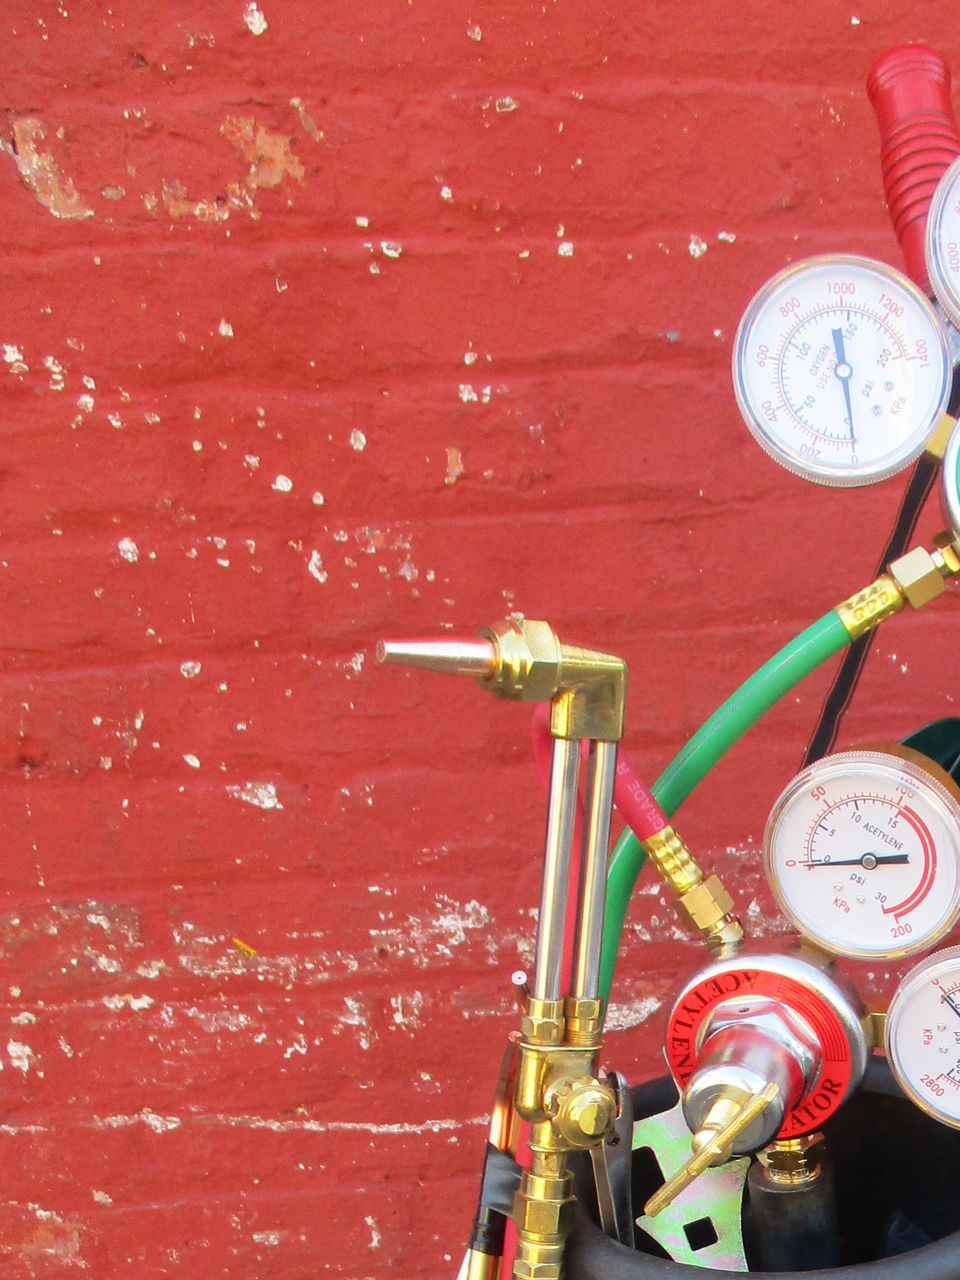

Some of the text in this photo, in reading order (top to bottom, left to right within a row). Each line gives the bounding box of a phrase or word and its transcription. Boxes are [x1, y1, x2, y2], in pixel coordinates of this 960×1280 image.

[947, 242, 960, 273] 4000
[826, 282, 856, 295] 1000
[779, 297, 802, 318] 800
[879, 293, 904, 318] 1200
[756, 344, 770, 367] 600
[797, 342, 811, 361] 100
[809, 344, 832, 377] OXYGEN
[877, 348, 892, 369] 200
[915, 339, 931, 369] 1400
[862, 379, 875, 398] psi
[761, 400, 779, 423] 400
[804, 394, 816, 410] 50
[889, 396, 907, 417] KPa
[799, 443, 822, 459] 200
[811, 785, 826, 801] 50
[627, 779, 665, 831] GRADE
[850, 811, 862, 823] 10
[887, 817, 899, 829] 15
[828, 828, 836, 838] 5
[862, 822, 904, 852] ACETYLENE
[850, 871, 868, 886] psi
[832, 896, 851, 914] KPa
[875, 891, 888, 904] 30
[890, 922, 913, 939] 200
[922, 1028, 933, 1046] KPa
[919, 1074, 945, 1097] 2800
